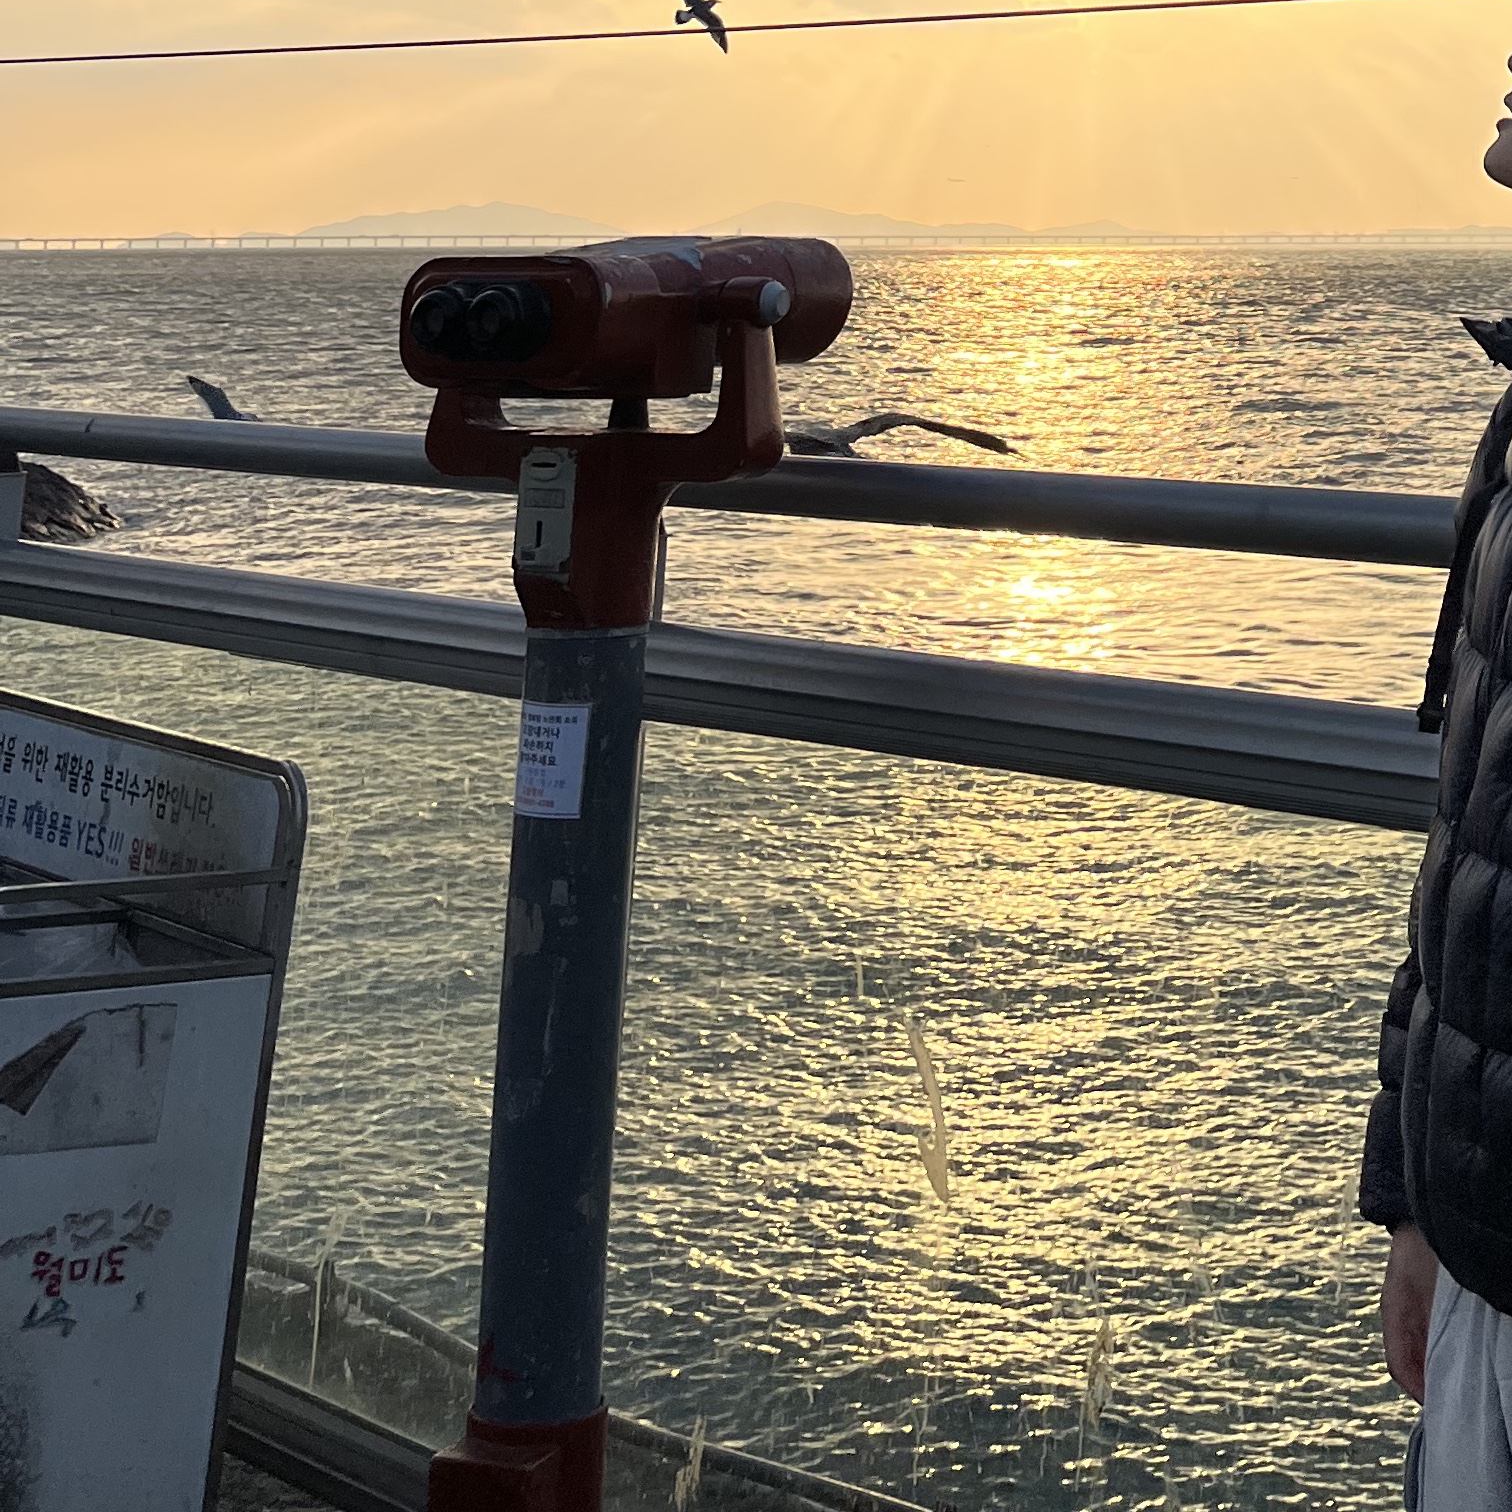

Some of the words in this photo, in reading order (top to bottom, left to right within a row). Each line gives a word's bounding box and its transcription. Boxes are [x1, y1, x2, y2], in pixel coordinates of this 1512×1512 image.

[21, 741, 49, 784] 위한
[54, 752, 94, 797] 재활용
[31, 1245, 129, 1298] 월미도
